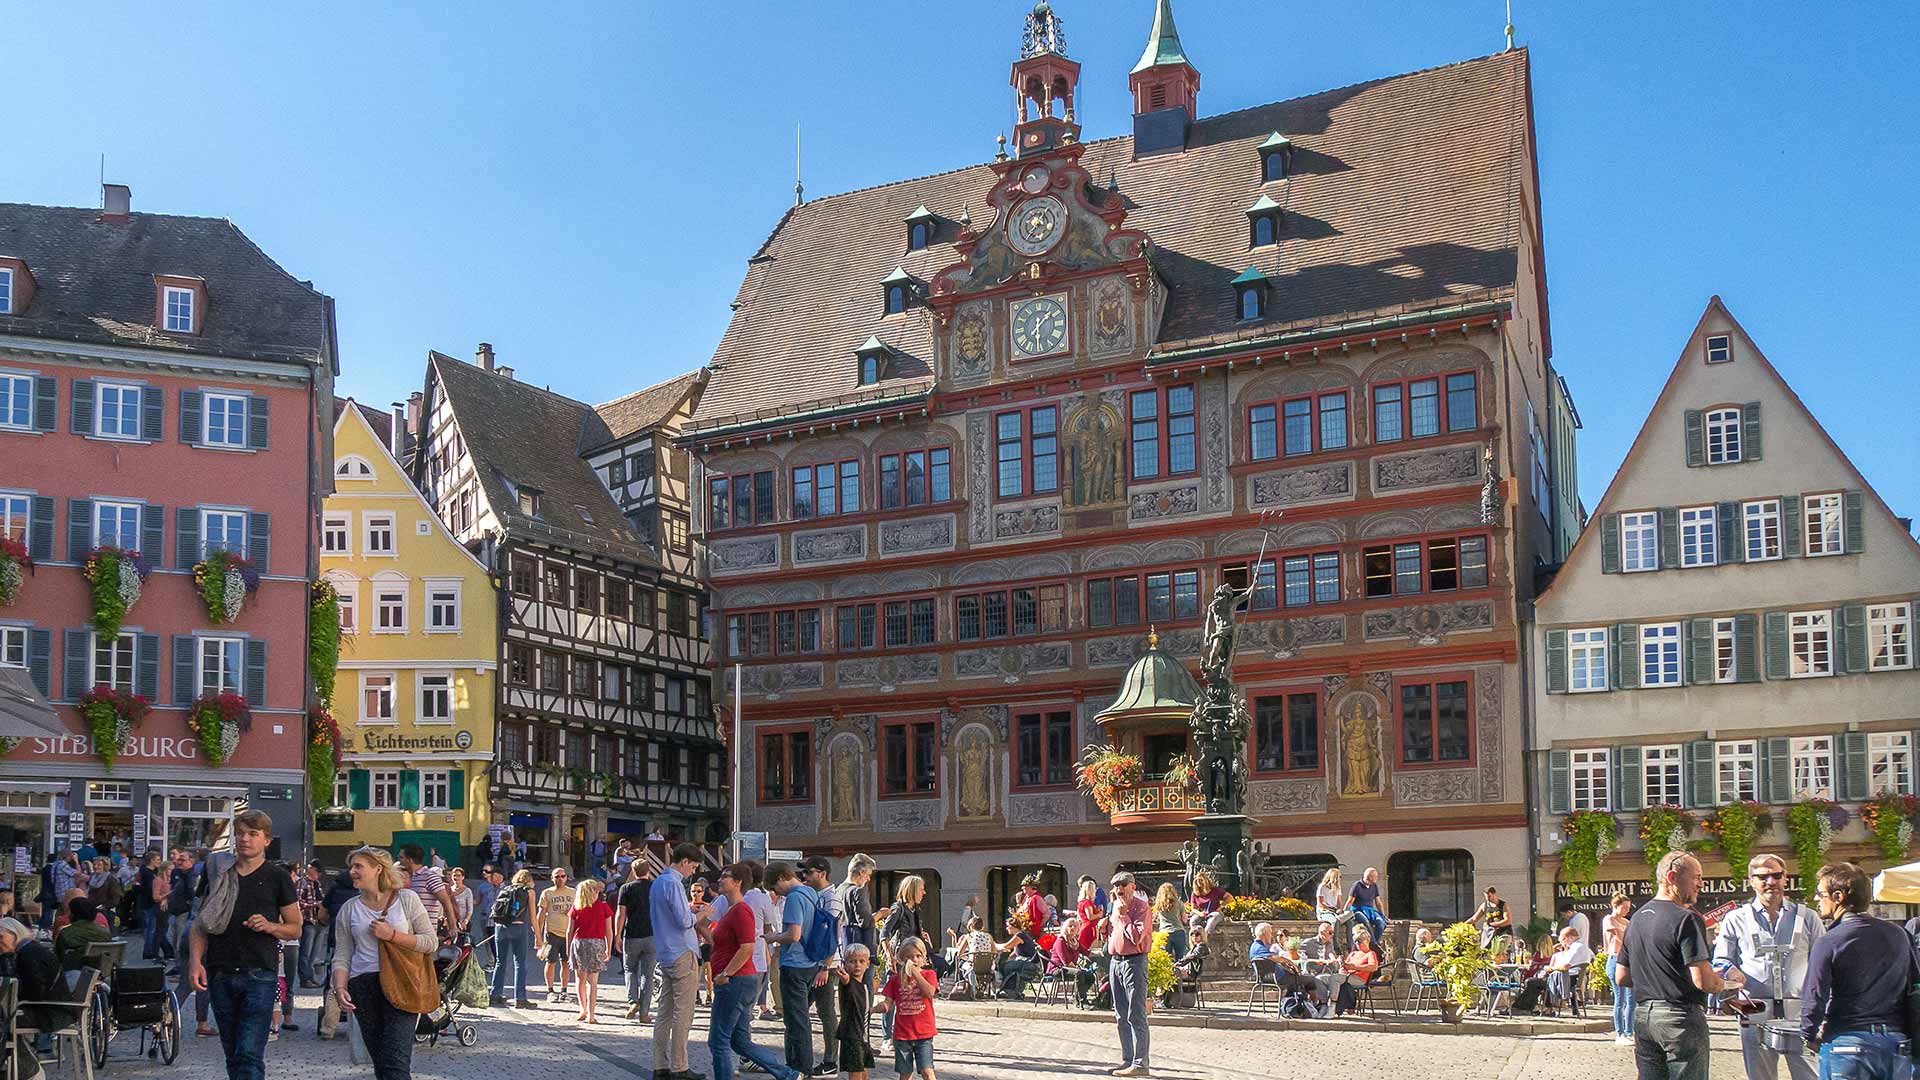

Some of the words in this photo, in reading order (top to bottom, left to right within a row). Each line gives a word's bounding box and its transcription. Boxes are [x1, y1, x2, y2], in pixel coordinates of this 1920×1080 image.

[33, 735, 196, 758] SILBBURG
[363, 730, 453, 750] Lichtenstein
[1558, 882, 1636, 897] MRQUART
